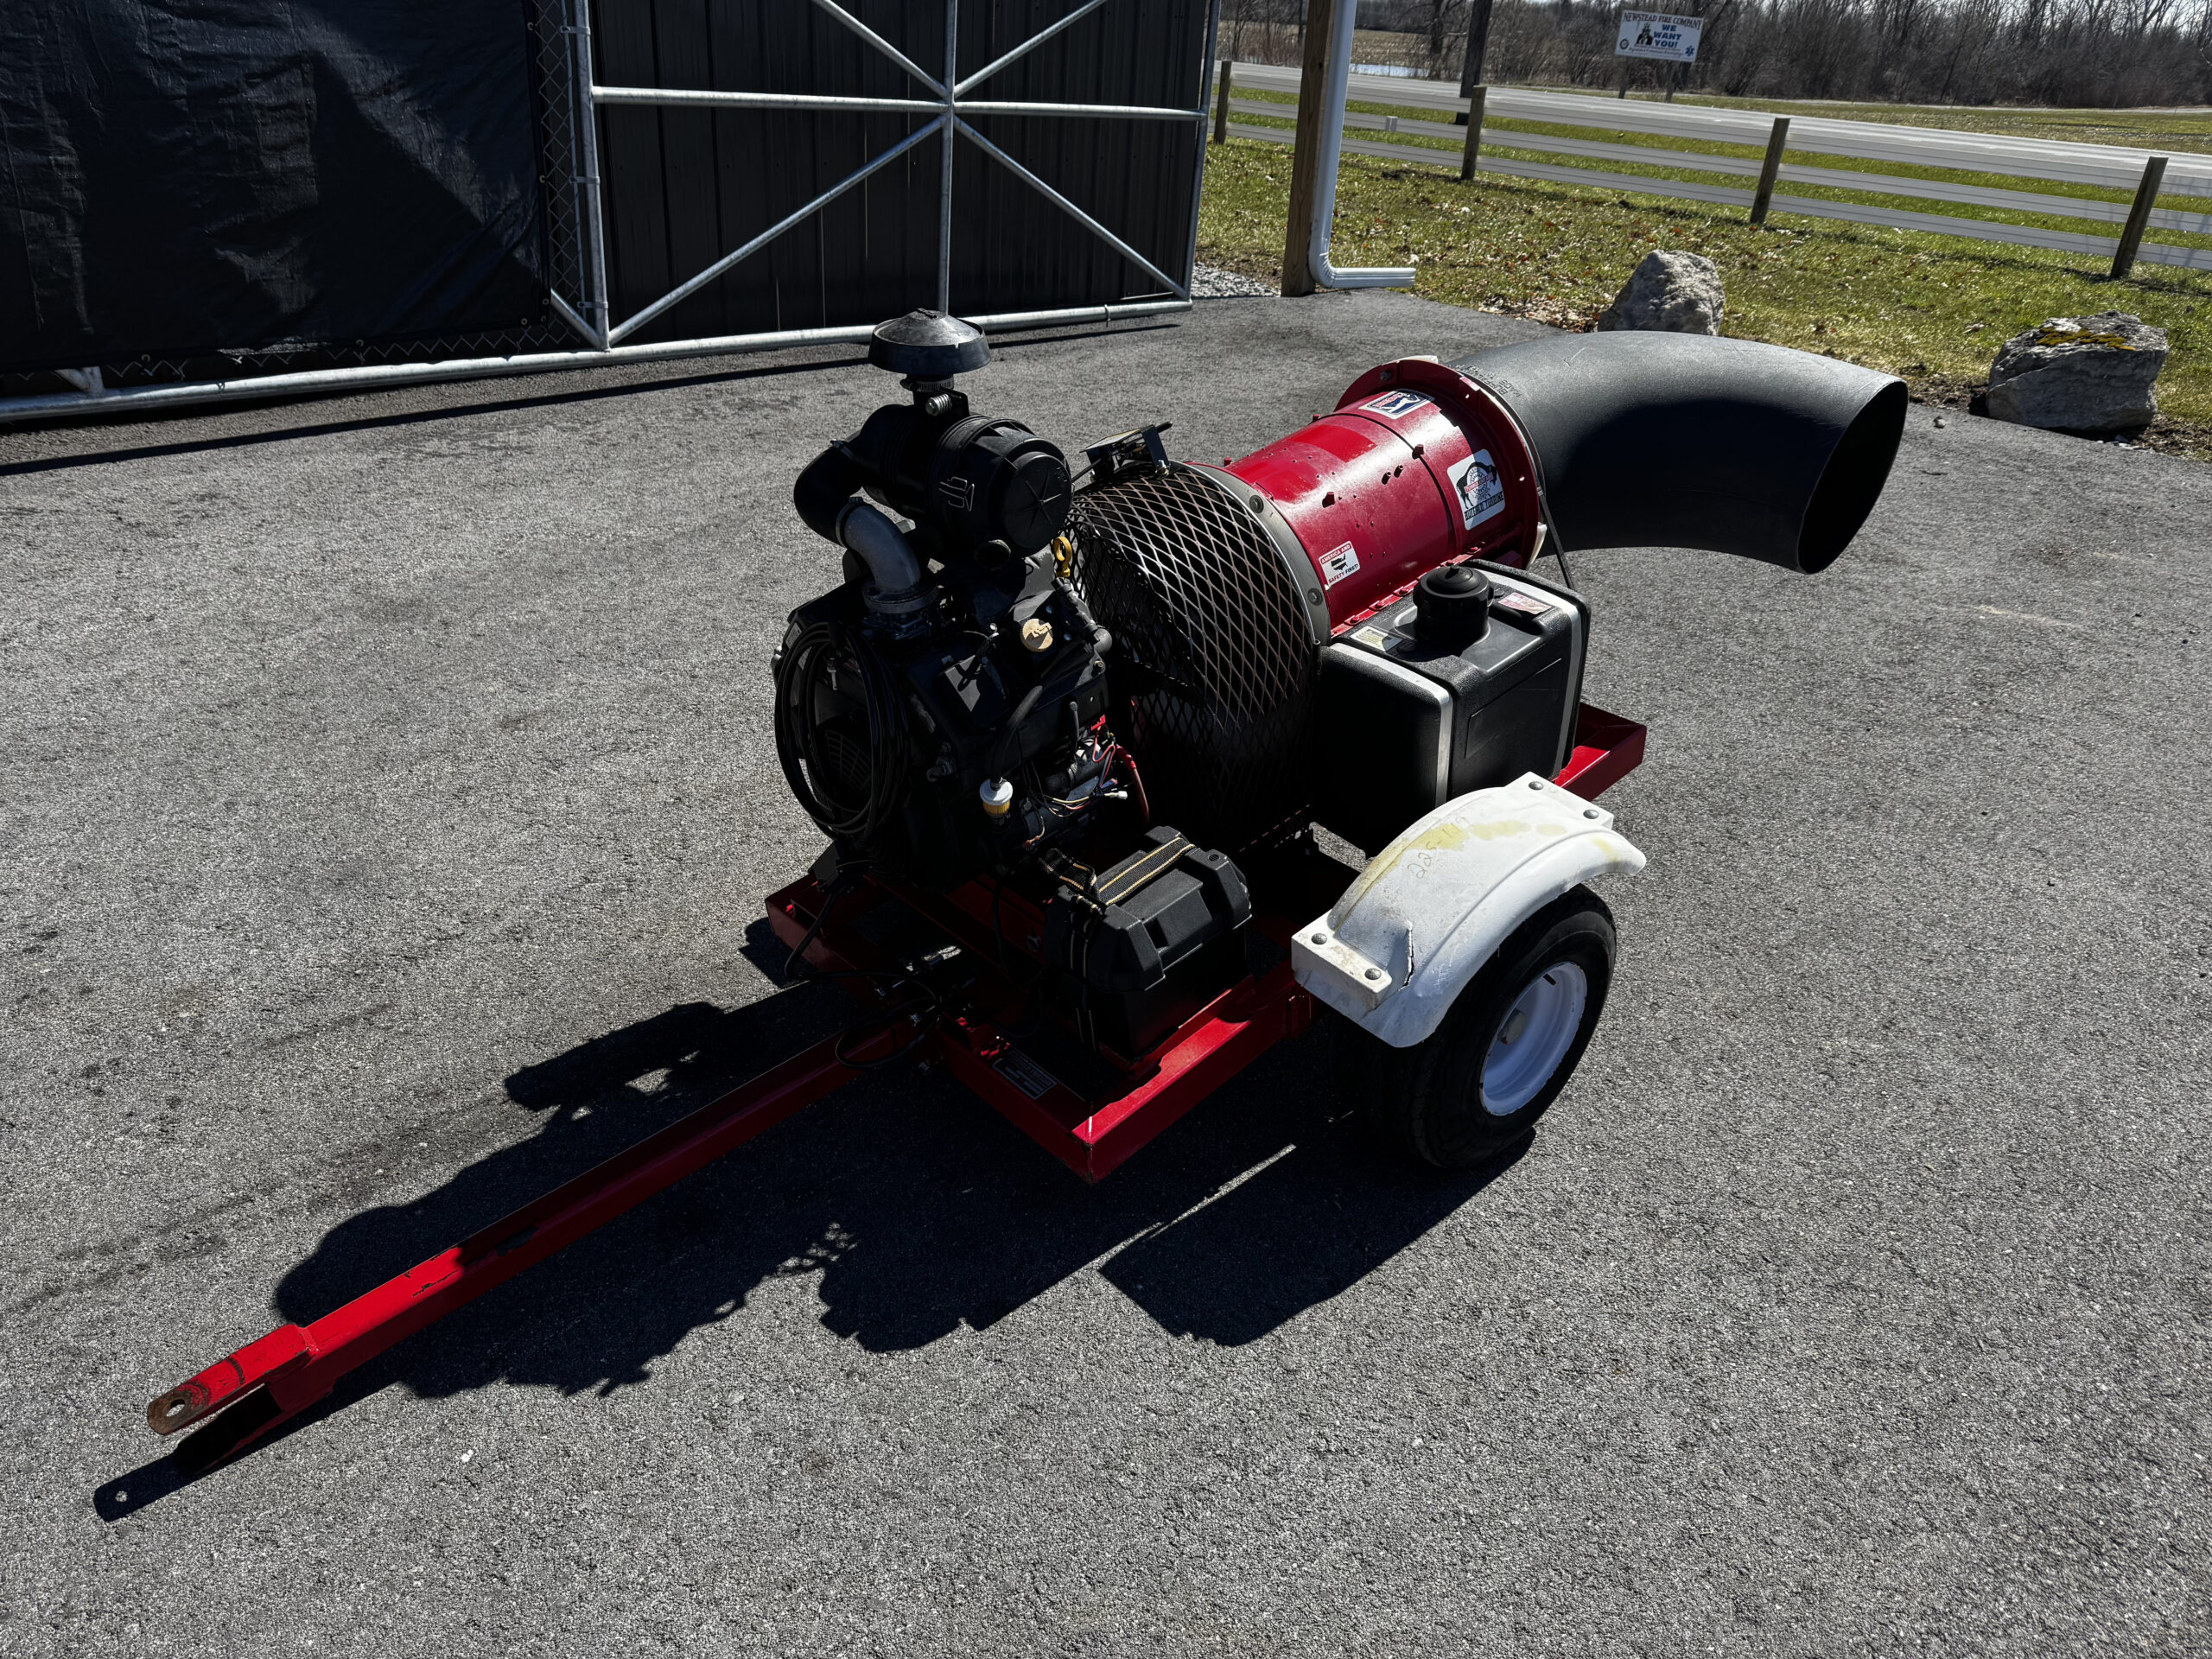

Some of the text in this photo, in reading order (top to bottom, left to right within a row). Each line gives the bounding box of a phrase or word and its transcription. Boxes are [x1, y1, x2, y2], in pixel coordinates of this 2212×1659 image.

[1624, 12, 1657, 22] NEWSTEAD
[1672, 17, 1702, 30] COMPANY
[1662, 23, 1677, 32] WE
[1653, 31, 1682, 41] WANT
[1655, 40, 1679, 48] YOU!
[1322, 543, 1351, 563] AMERICA AND
[1328, 571, 1344, 583] SAFETY
